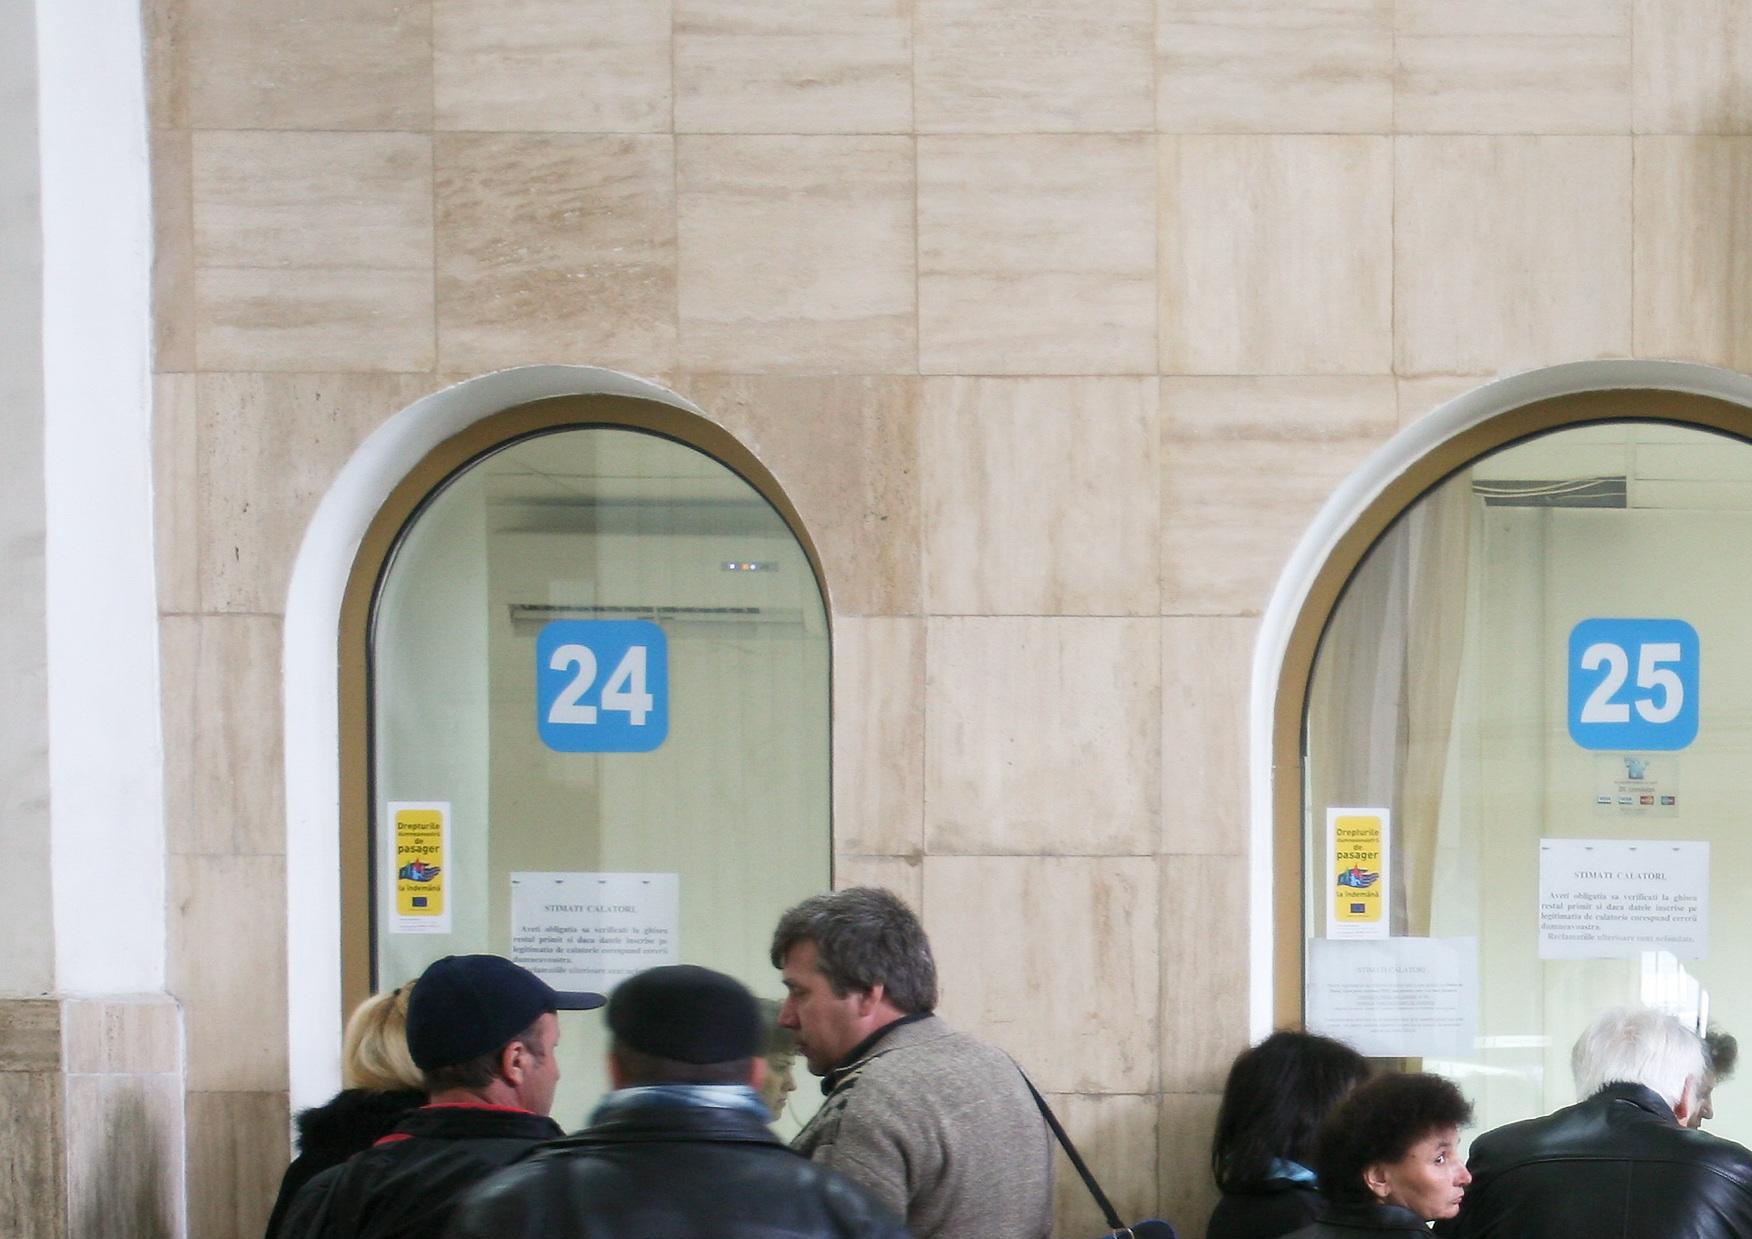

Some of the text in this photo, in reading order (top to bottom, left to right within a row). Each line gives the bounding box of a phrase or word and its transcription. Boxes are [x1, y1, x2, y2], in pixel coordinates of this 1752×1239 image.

[548, 644, 653, 726] 24
[1580, 642, 1684, 724] 25
[397, 822, 440, 831] Drepturile
[1336, 828, 1379, 837] Drepturile
[398, 845, 440, 855] pasager
[1337, 851, 1378, 861] pasager
[1574, 871, 1613, 880] STIMATI
